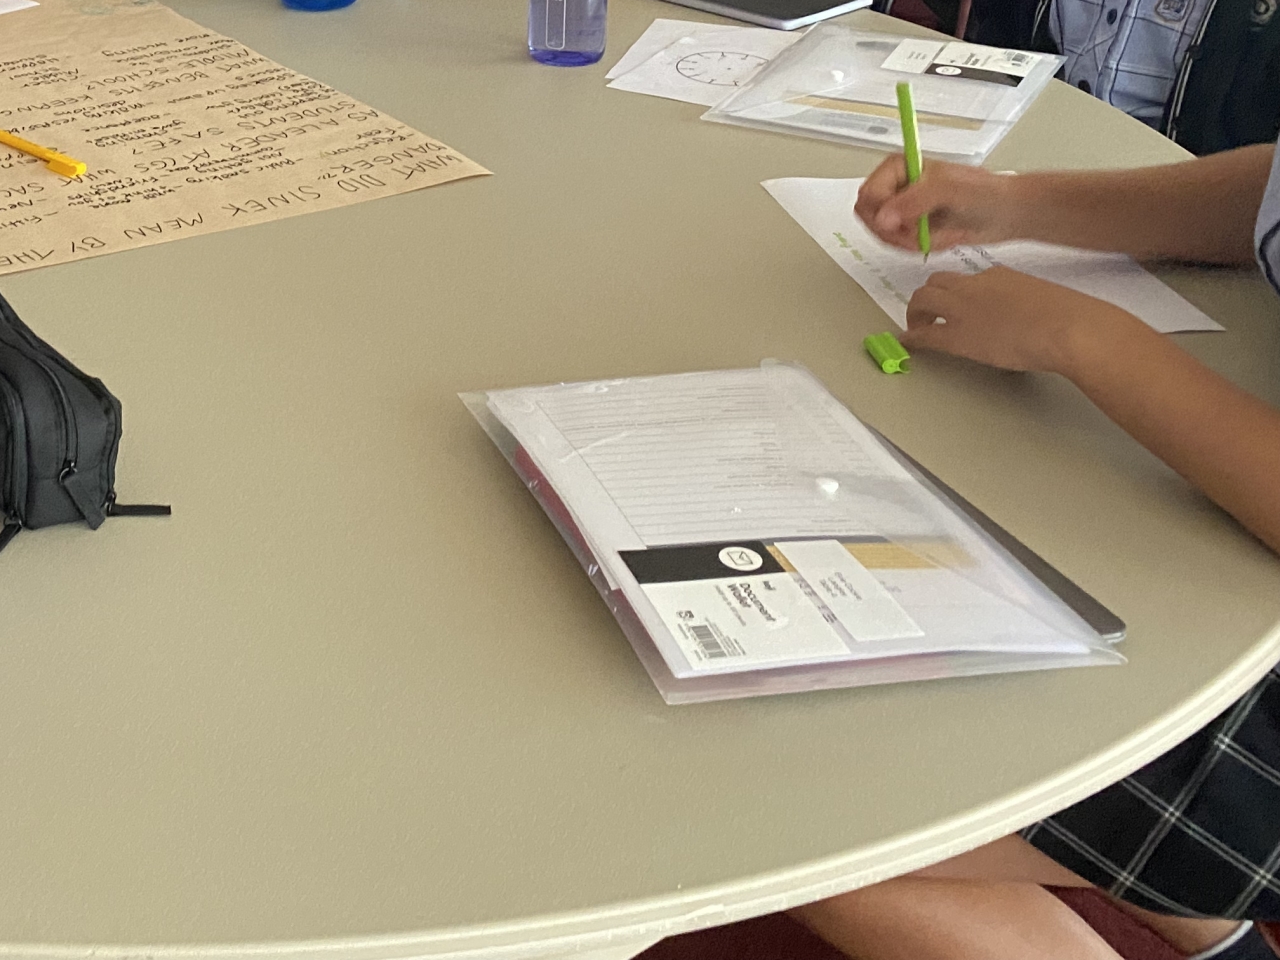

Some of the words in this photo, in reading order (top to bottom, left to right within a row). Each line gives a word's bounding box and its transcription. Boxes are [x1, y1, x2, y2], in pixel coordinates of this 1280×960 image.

[178, 49, 249, 69] MIDDLE
[215, 58, 264, 72] WHAT
[81, 67, 173, 91] SCHOOL?
[109, 71, 210, 96] BENEFITS
[237, 101, 355, 130] STUDENTS
[348, 110, 378, 121] AS
[220, 124, 322, 152] LEADER
[134, 157, 176, 173] CGS
[182, 148, 210, 164] AT
[391, 155, 463, 180] WHAT
[58, 169, 116, 187] WHAT
[337, 174, 386, 192] DID
[221, 186, 321, 217] SINEK
[124, 212, 203, 240] MEAN
[72, 236, 106, 253] BY
[727, 583, 752, 608] Wallet
[740, 583, 777, 622] Document
